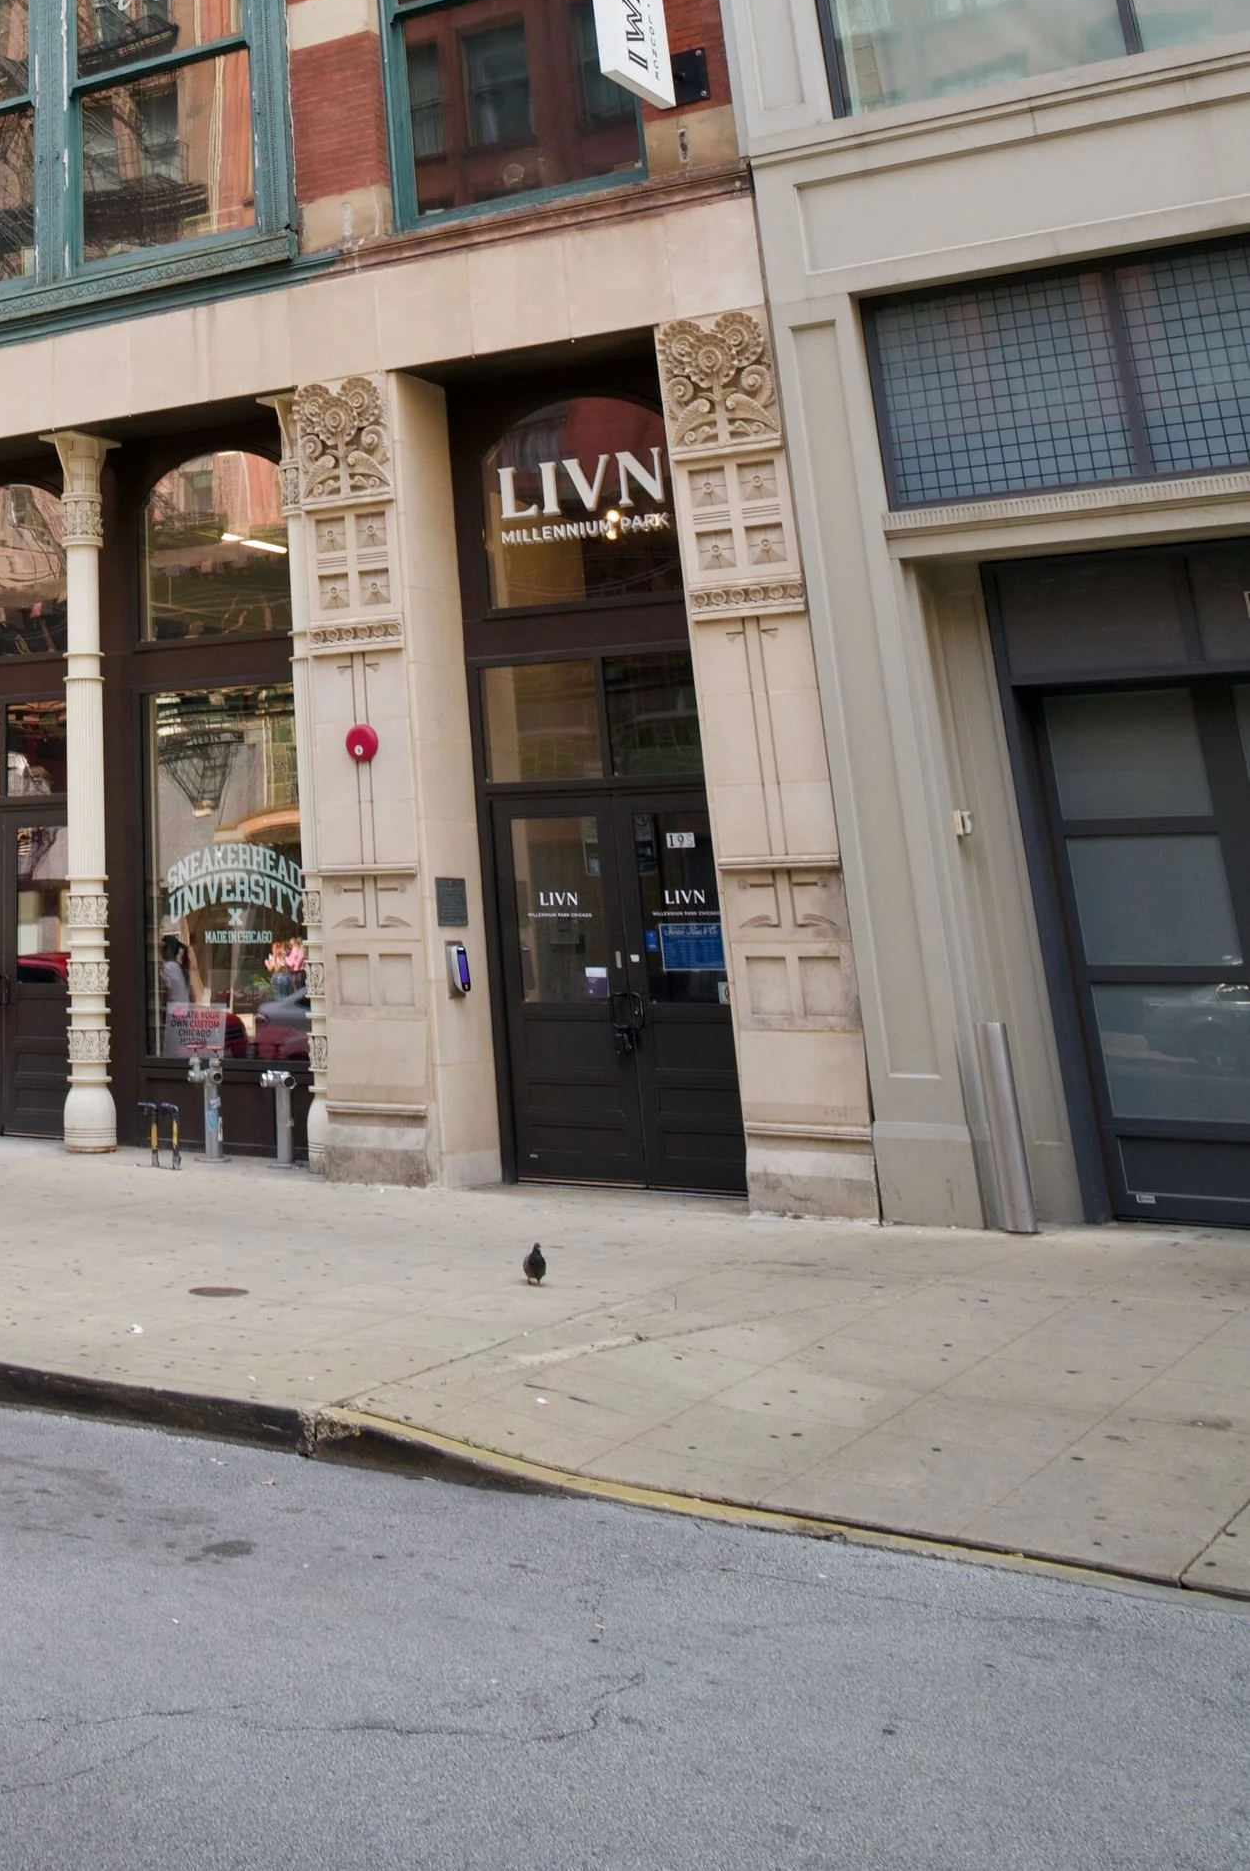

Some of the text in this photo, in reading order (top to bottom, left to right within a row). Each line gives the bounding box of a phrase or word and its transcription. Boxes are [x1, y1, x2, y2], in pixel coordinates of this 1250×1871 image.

[497, 447, 666, 520] LIVN
[501, 512, 670, 545] MILLENNIUM PARK
[167, 843, 303, 893] SNEAKERHEAD
[168, 872, 302, 924] UNIVERSITY
[539, 892, 578, 906] LIVN
[664, 889, 706, 904] LIVN
[228, 908, 244, 926] X
[204, 930, 273, 944] MADE IN CHICAGO
[201, 1010, 220, 1019] YOUR
[171, 1019, 220, 1029] OWN CUSTOM
[178, 1029, 211, 1038] CHICAGO
